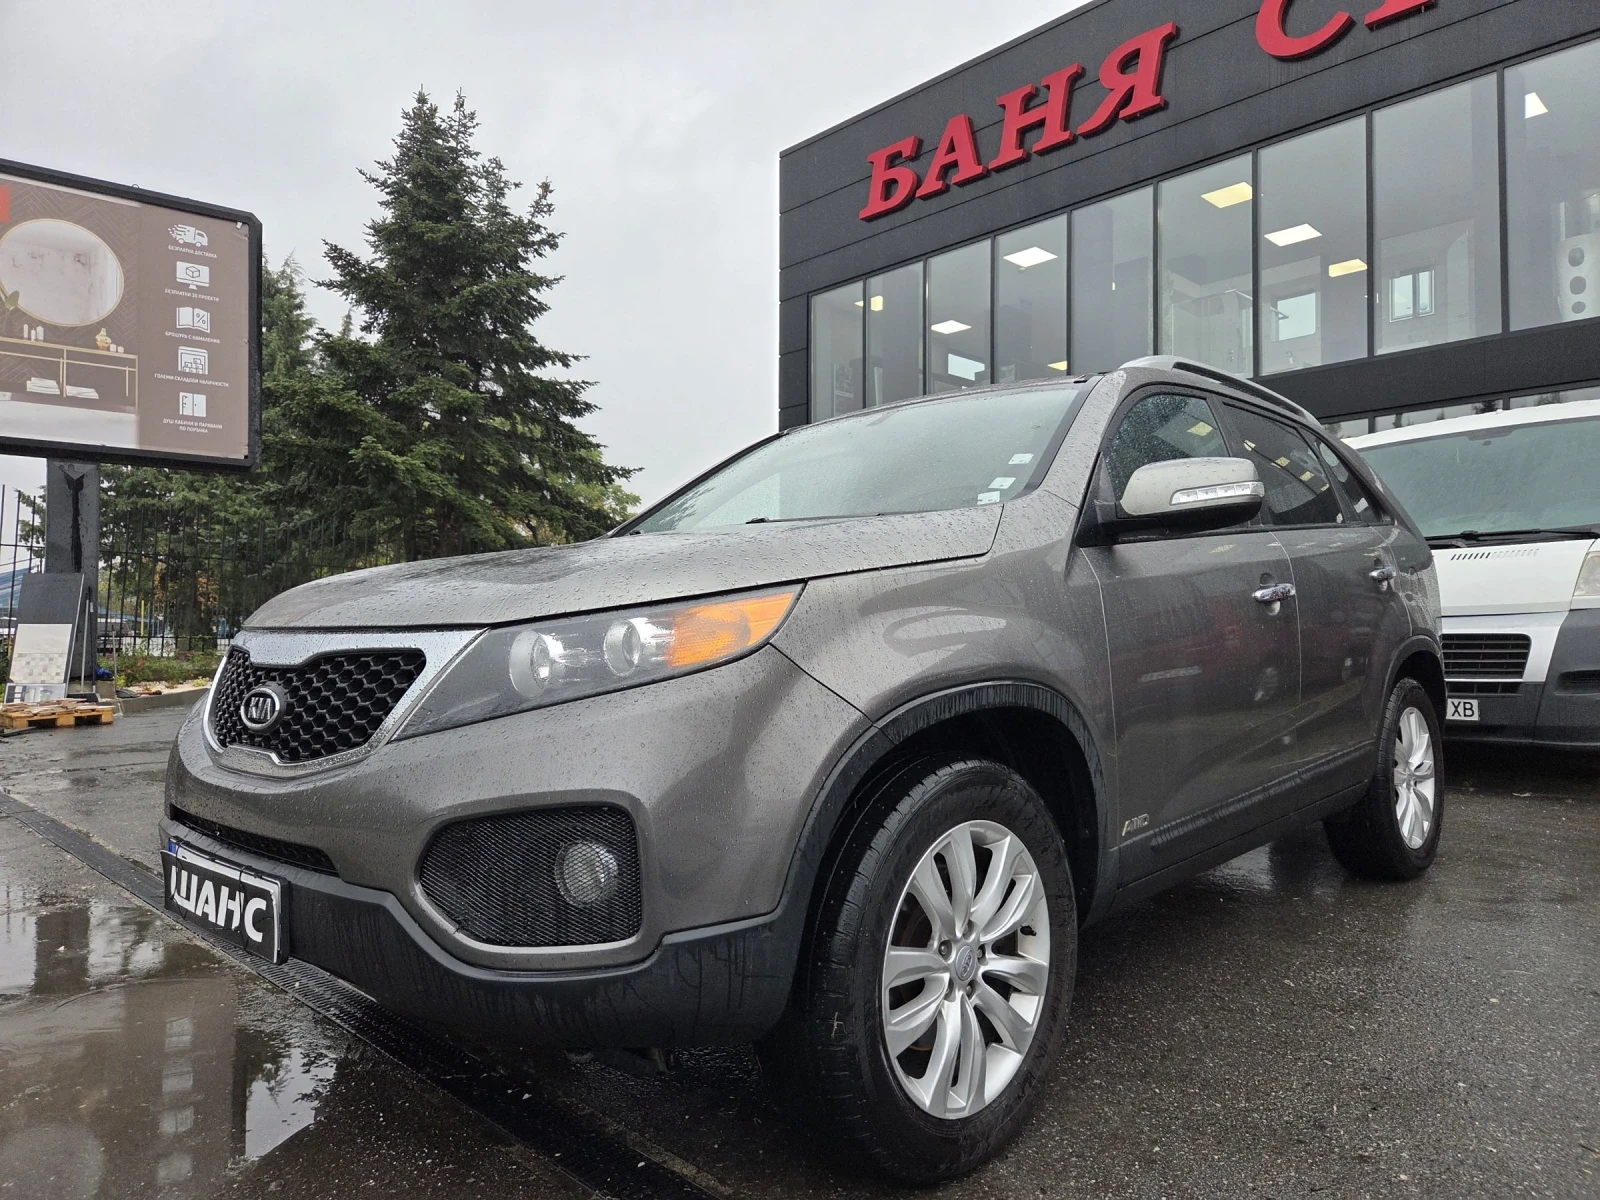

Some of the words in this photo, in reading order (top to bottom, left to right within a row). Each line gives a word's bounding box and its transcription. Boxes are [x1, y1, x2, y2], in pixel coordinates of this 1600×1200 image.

[859, 21, 1178, 221] БАНЯ
[168, 245, 194, 254] БЕЗПЛАТНА
[194, 250, 217, 258] ДОСТАВКА
[154, 373, 174, 381] ГОЛЕМИ
[247, 696, 272, 720] KIA
[170, 864, 267, 943] ШАНС
